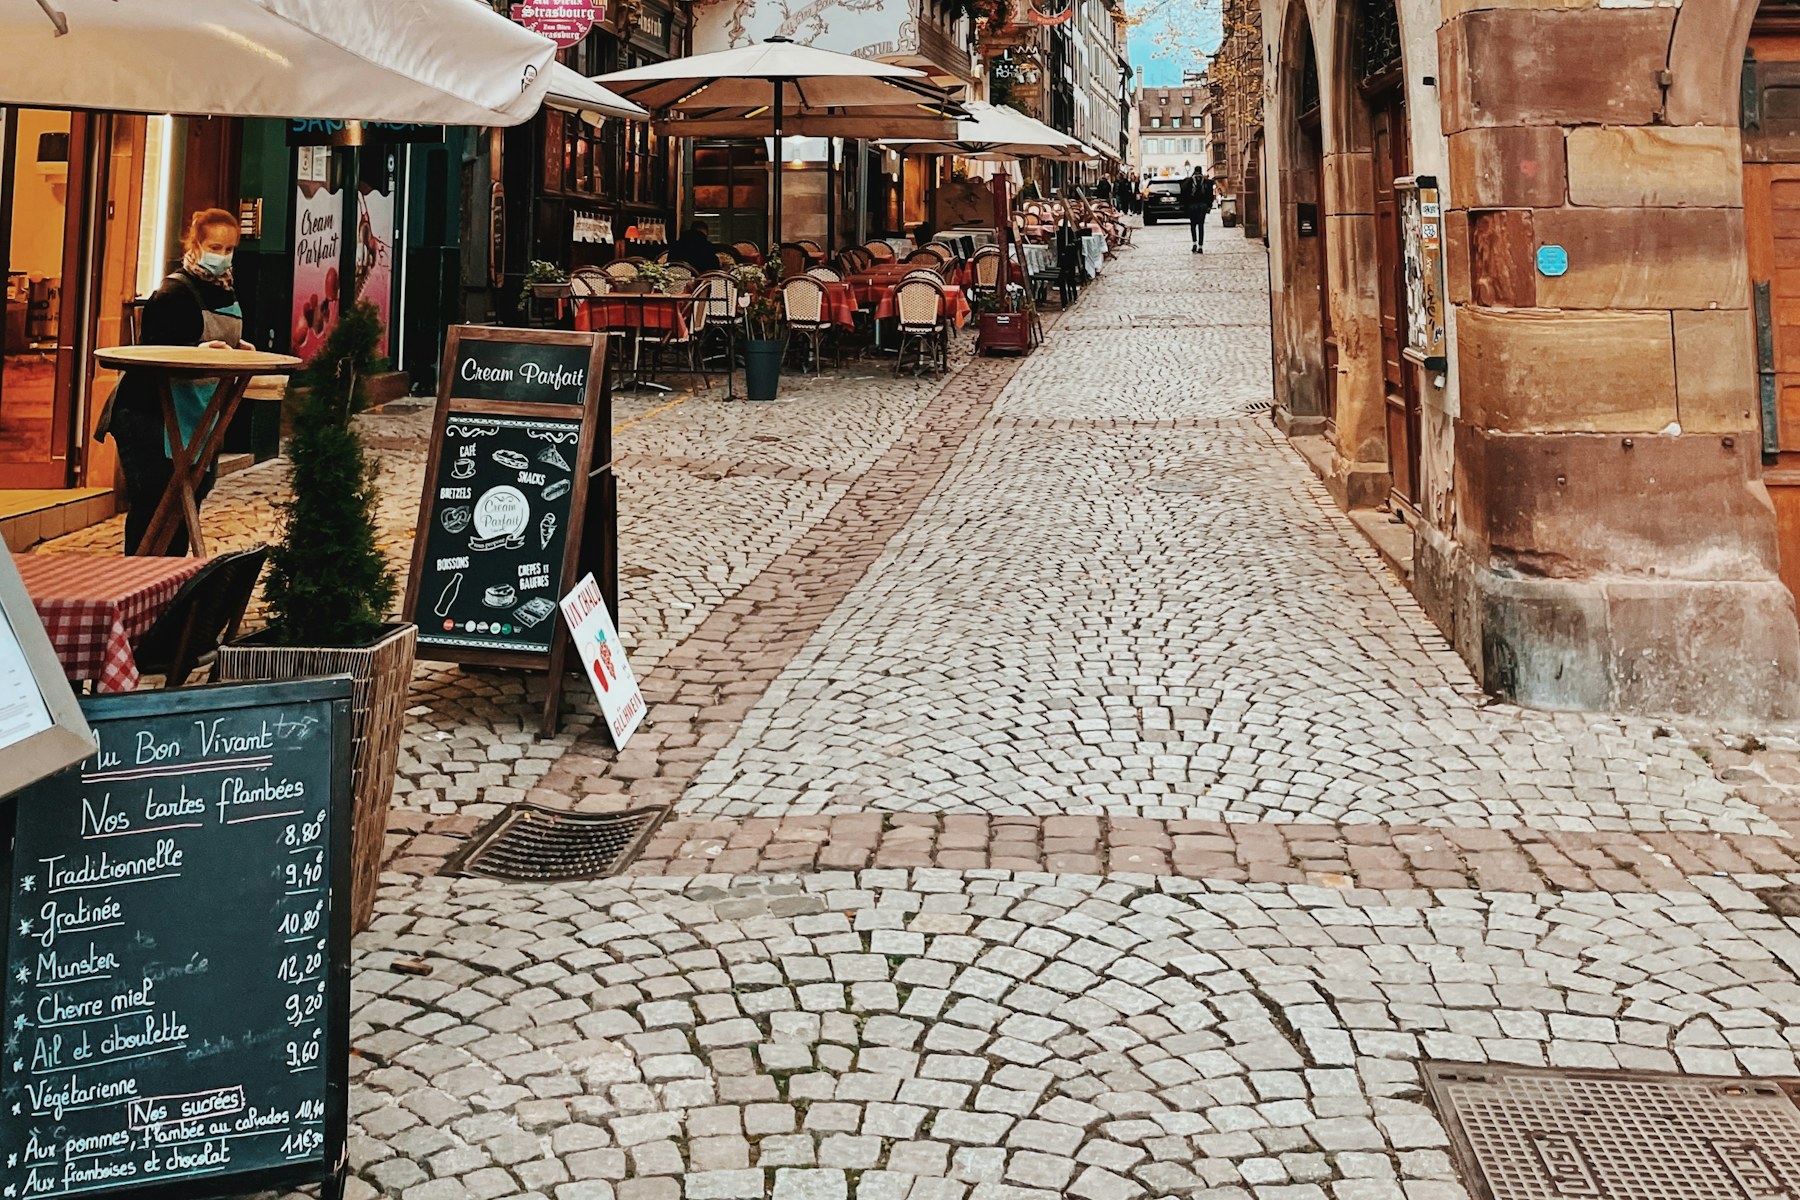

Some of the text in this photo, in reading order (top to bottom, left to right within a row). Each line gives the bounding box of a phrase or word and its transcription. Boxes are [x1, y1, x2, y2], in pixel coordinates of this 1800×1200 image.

[521, 5, 595, 20] Strasbourg
[301, 208, 334, 236] Cream
[297, 232, 339, 268] Parfait
[461, 357, 584, 391] Cream Parfait
[459, 442, 477, 458] CAFÉ
[440, 487, 472, 500] BRETZELS
[517, 470, 546, 486] SNACKS
[484, 500, 516, 513] Cream
[484, 513, 519, 532] Parfait
[437, 556, 469, 571] BOISSONS
[519, 575, 550, 591] GAUFRES
[564, 601, 583, 630] VIN
[136, 731, 180, 765] Bon
[195, 718, 273, 757] Vivant
[81, 777, 304, 836] Nos tartes flambées
[39, 838, 183, 888] Traditionnelle
[36, 942, 120, 981] Munster
[37, 977, 155, 1024] Chèvre miel
[31, 1034, 62, 1070] Ail
[73, 1029, 93, 1061] et
[101, 1011, 189, 1054] ciboulette
[24, 1075, 138, 1121] Végétarienne
[133, 1090, 239, 1124] Nos sucrées
[24, 1135, 57, 1163] Aux
[142, 1122, 205, 1150] flambée
[210, 1119, 231, 1135] au
[235, 1106, 290, 1131] calvados
[22, 1137, 230, 1195] Aux framboises et chocolat
